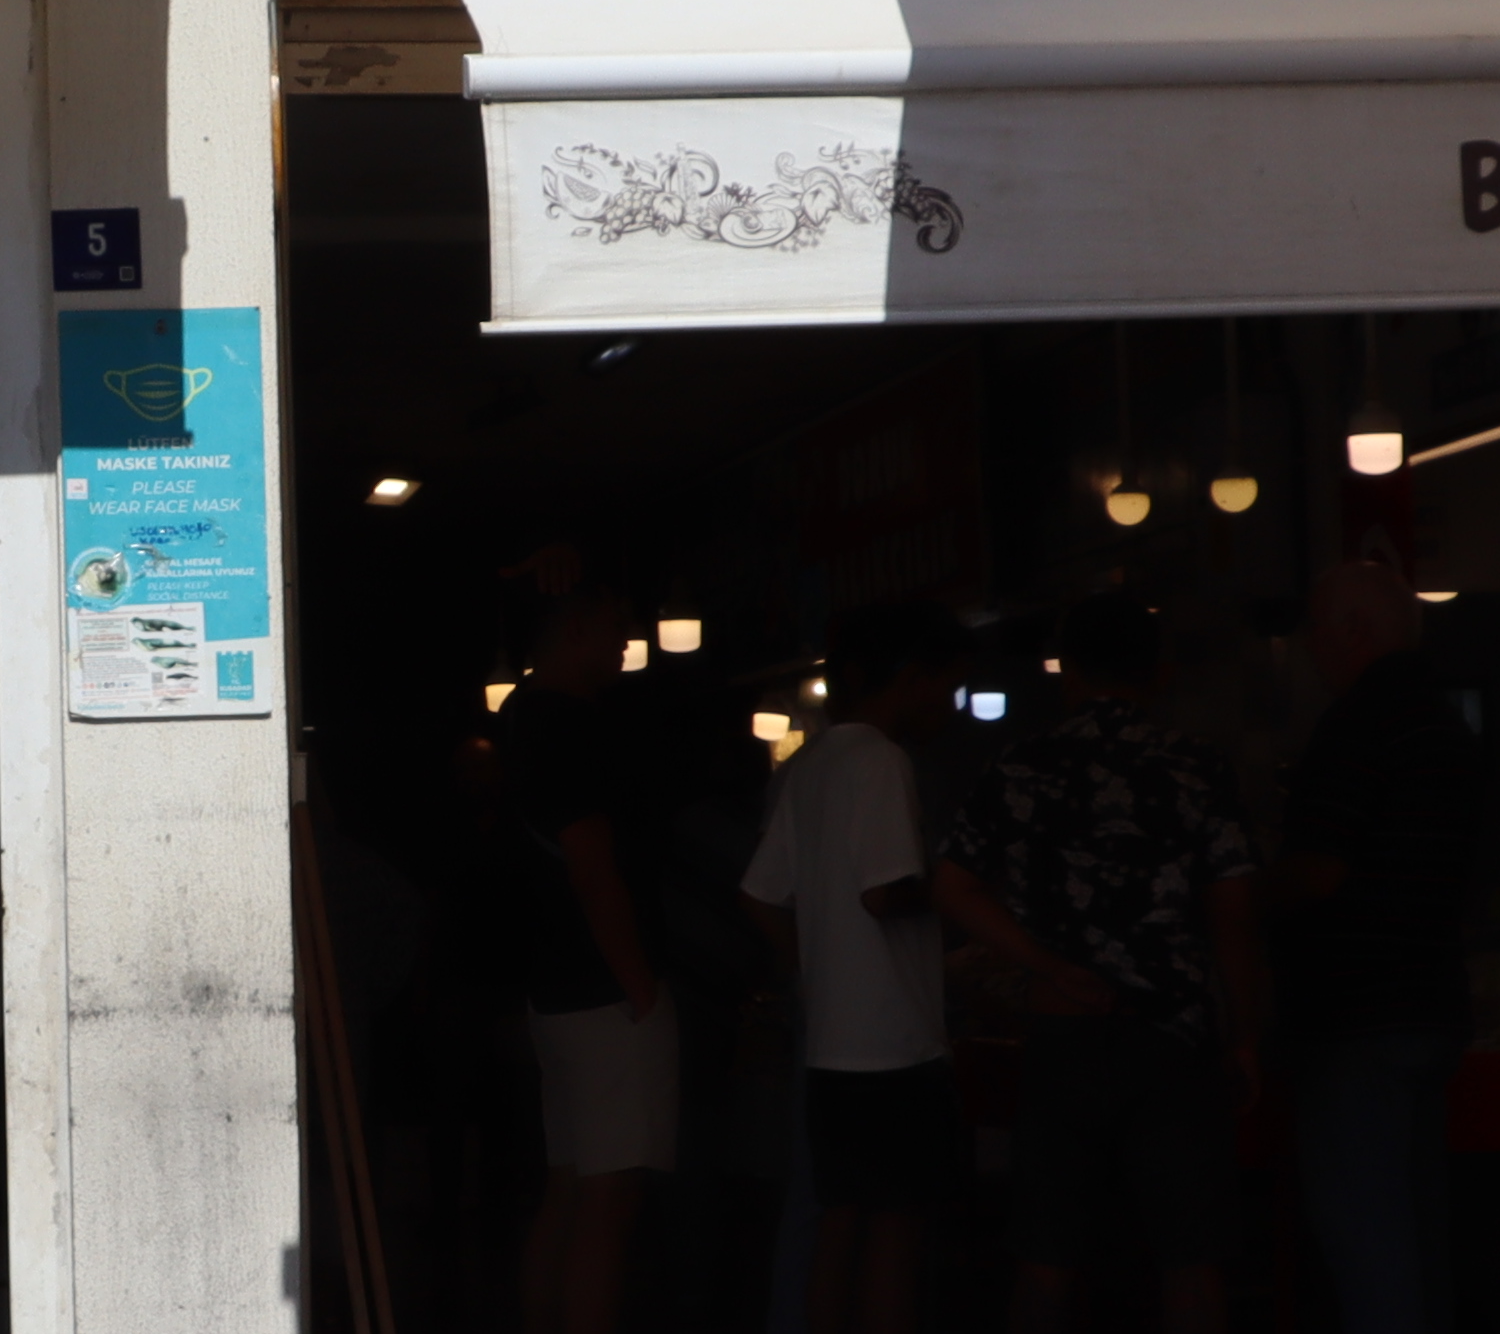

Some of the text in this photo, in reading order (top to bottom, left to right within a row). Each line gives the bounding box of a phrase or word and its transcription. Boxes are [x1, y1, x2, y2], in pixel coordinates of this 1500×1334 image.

[88, 222, 108, 257] 5
[127, 435, 195, 452] LÜTFEN
[96, 454, 231, 471] MASKE TAKINIZ
[131, 480, 197, 496] PLEASE
[89, 497, 242, 516] WEAR FACE MASK
